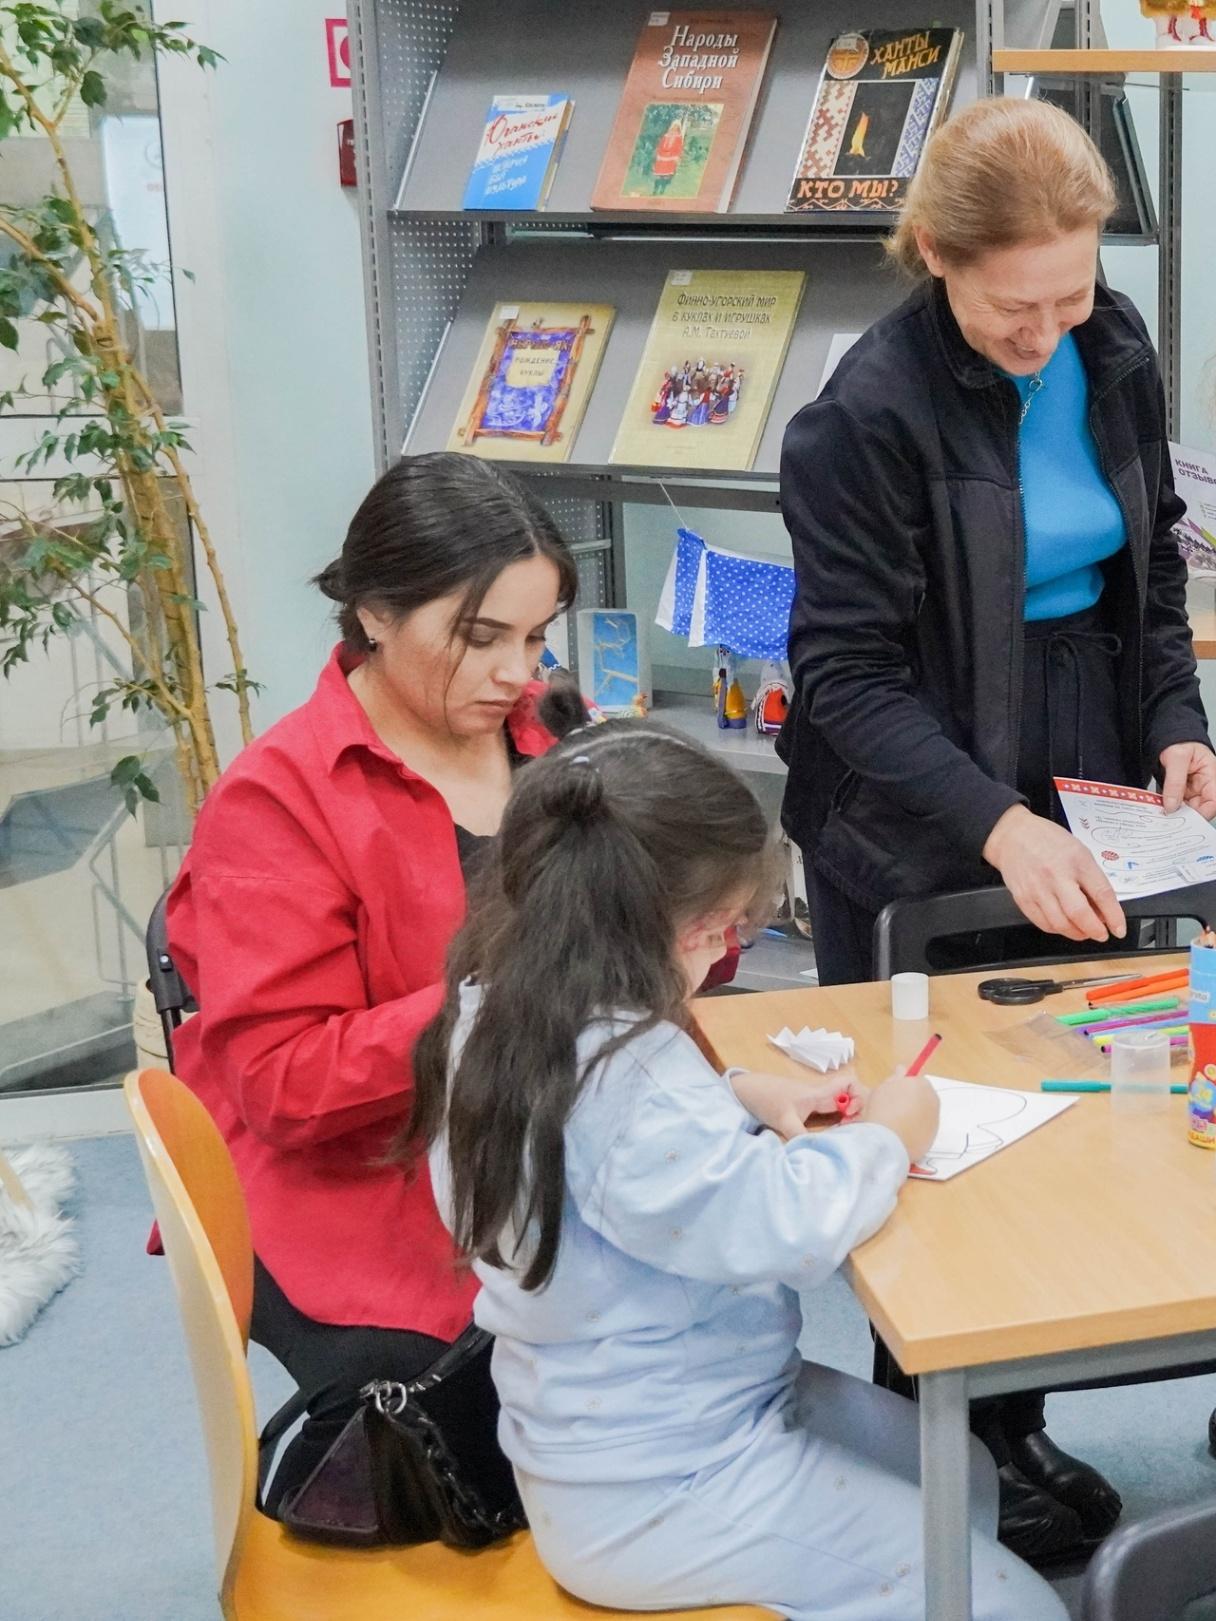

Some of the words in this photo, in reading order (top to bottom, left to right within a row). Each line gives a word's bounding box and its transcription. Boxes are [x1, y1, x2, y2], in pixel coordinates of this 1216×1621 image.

[671, 25, 738, 52] Народы
[870, 31, 931, 65] ХАНТЫ
[658, 45, 740, 70] Западной
[881, 45, 942, 79] МАНСИ
[662, 67, 723, 95] Сибири
[797, 180, 845, 199] КТО
[848, 180, 899, 199] МЫ?
[1174, 458, 1209, 475] КНИГА
